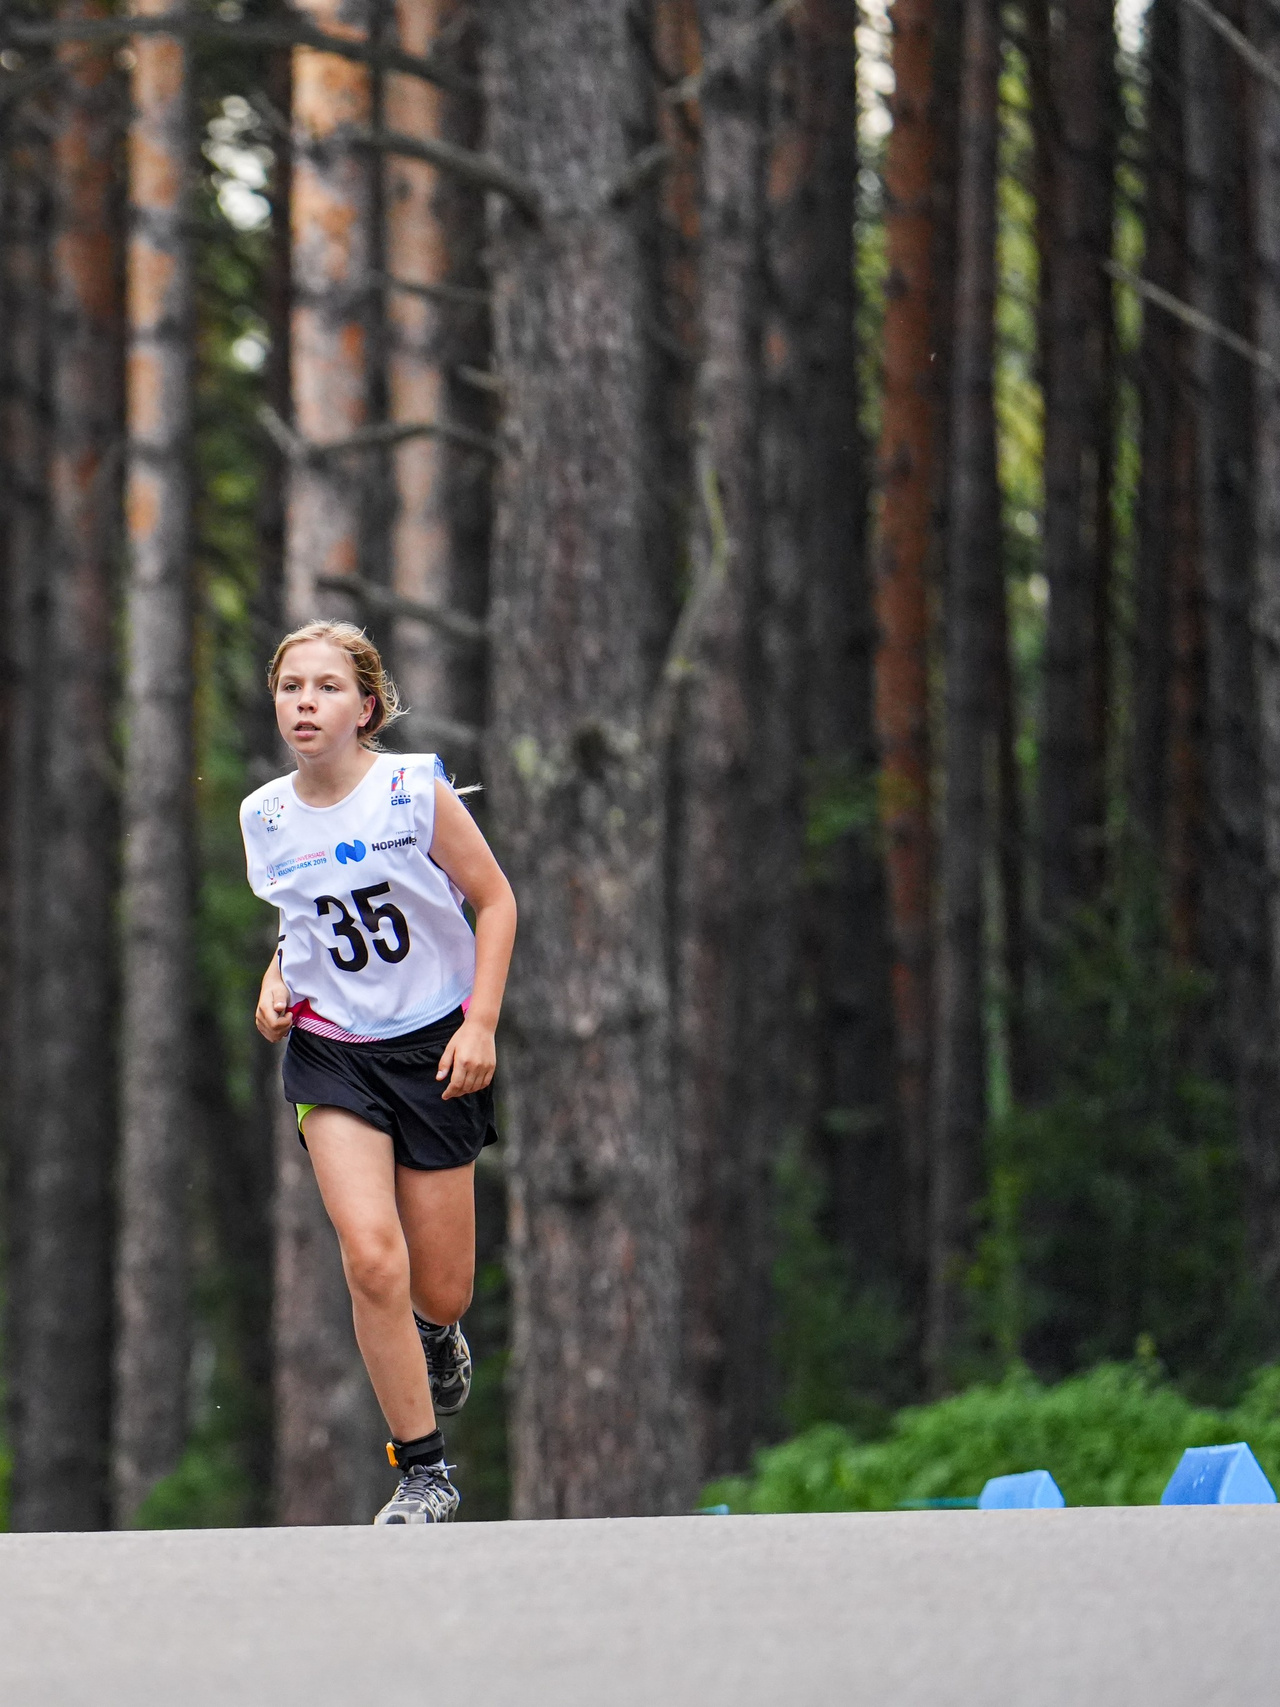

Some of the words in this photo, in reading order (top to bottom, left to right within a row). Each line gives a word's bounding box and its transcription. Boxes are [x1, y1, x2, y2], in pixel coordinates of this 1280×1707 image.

[391, 798, 412, 806] СБР
[313, 857, 327, 866] 2019
[313, 881, 410, 973] 35
